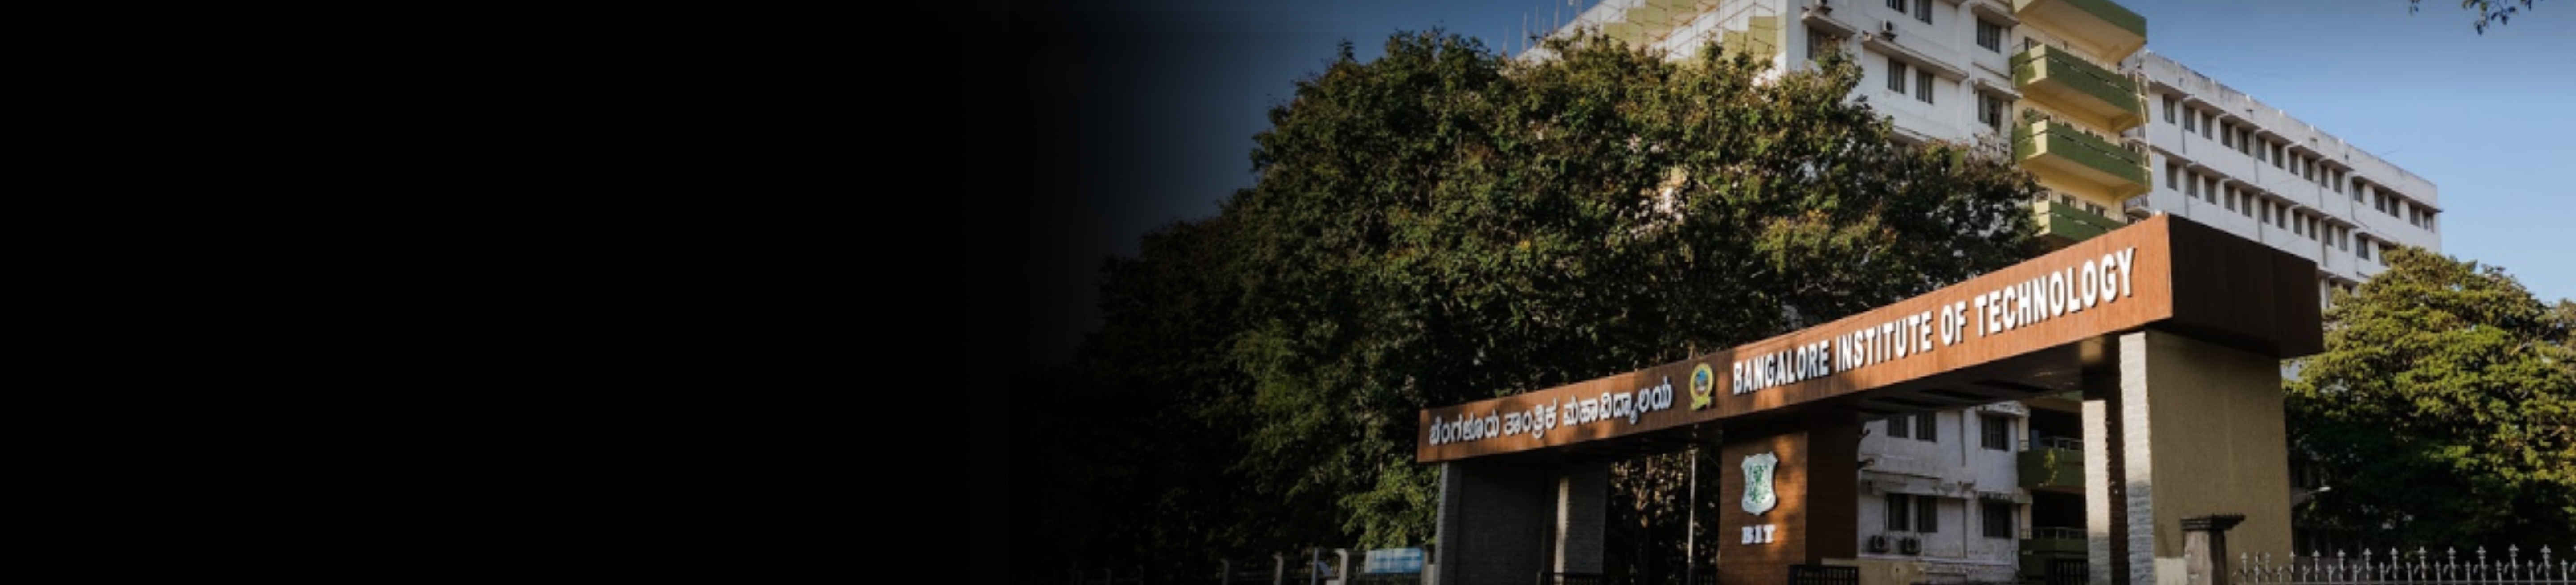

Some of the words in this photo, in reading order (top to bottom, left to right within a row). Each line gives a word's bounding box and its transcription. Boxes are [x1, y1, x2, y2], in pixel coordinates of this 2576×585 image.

[1733, 341, 1829, 395] BANGALORE
[1837, 311, 1933, 372] INSTITUTE
[1941, 301, 1967, 345] OF
[1975, 248, 2135, 336] TECHNOLOGY
[1429, 408, 1499, 446] ಬೆಂಗಳೂರು
[1504, 398, 1557, 439] ತಾಂತ್ರಿಕ
[1563, 376, 1672, 425] ಮಹಾವಿದ್ಯಾಲಯ
[1742, 524, 1776, 544] BIT
